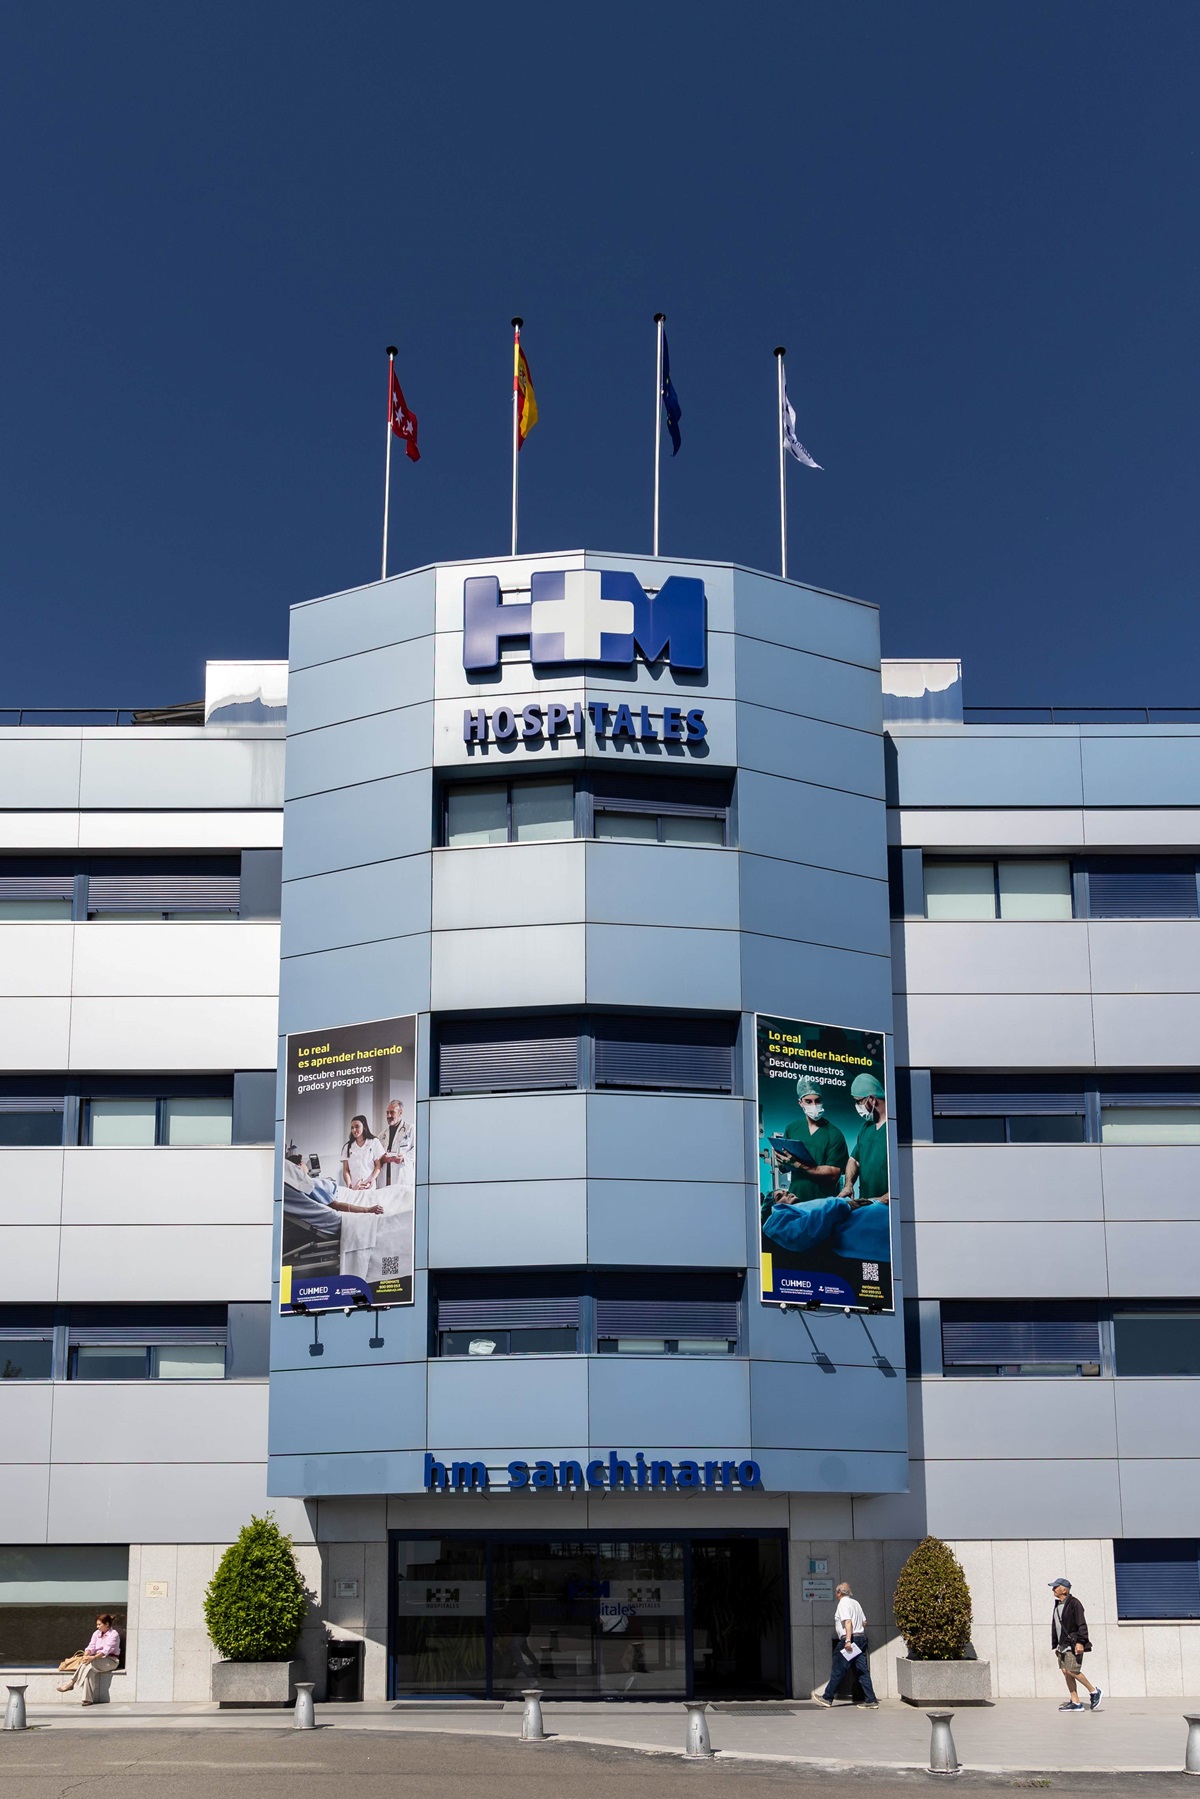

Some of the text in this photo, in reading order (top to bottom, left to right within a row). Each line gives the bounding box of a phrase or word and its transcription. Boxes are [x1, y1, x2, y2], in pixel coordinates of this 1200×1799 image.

[464, 702, 708, 743] HOSPITALES
[769, 1031, 801, 1043] Lo real
[298, 1045, 402, 1068] es aprender haciendo
[299, 1043, 329, 1056] Lo real
[769, 1044, 872, 1066] es aprender haciendo
[298, 1065, 372, 1082] Descubre nuestros
[769, 1058, 844, 1076] Descubre nuestros
[298, 1075, 374, 1094] grados y posgrados
[769, 1069, 846, 1086] grados y posgrados
[299, 1286, 328, 1296] CUHMED
[781, 1279, 811, 1288] CUHMED
[424, 1451, 761, 1487] hm sanchinarro
